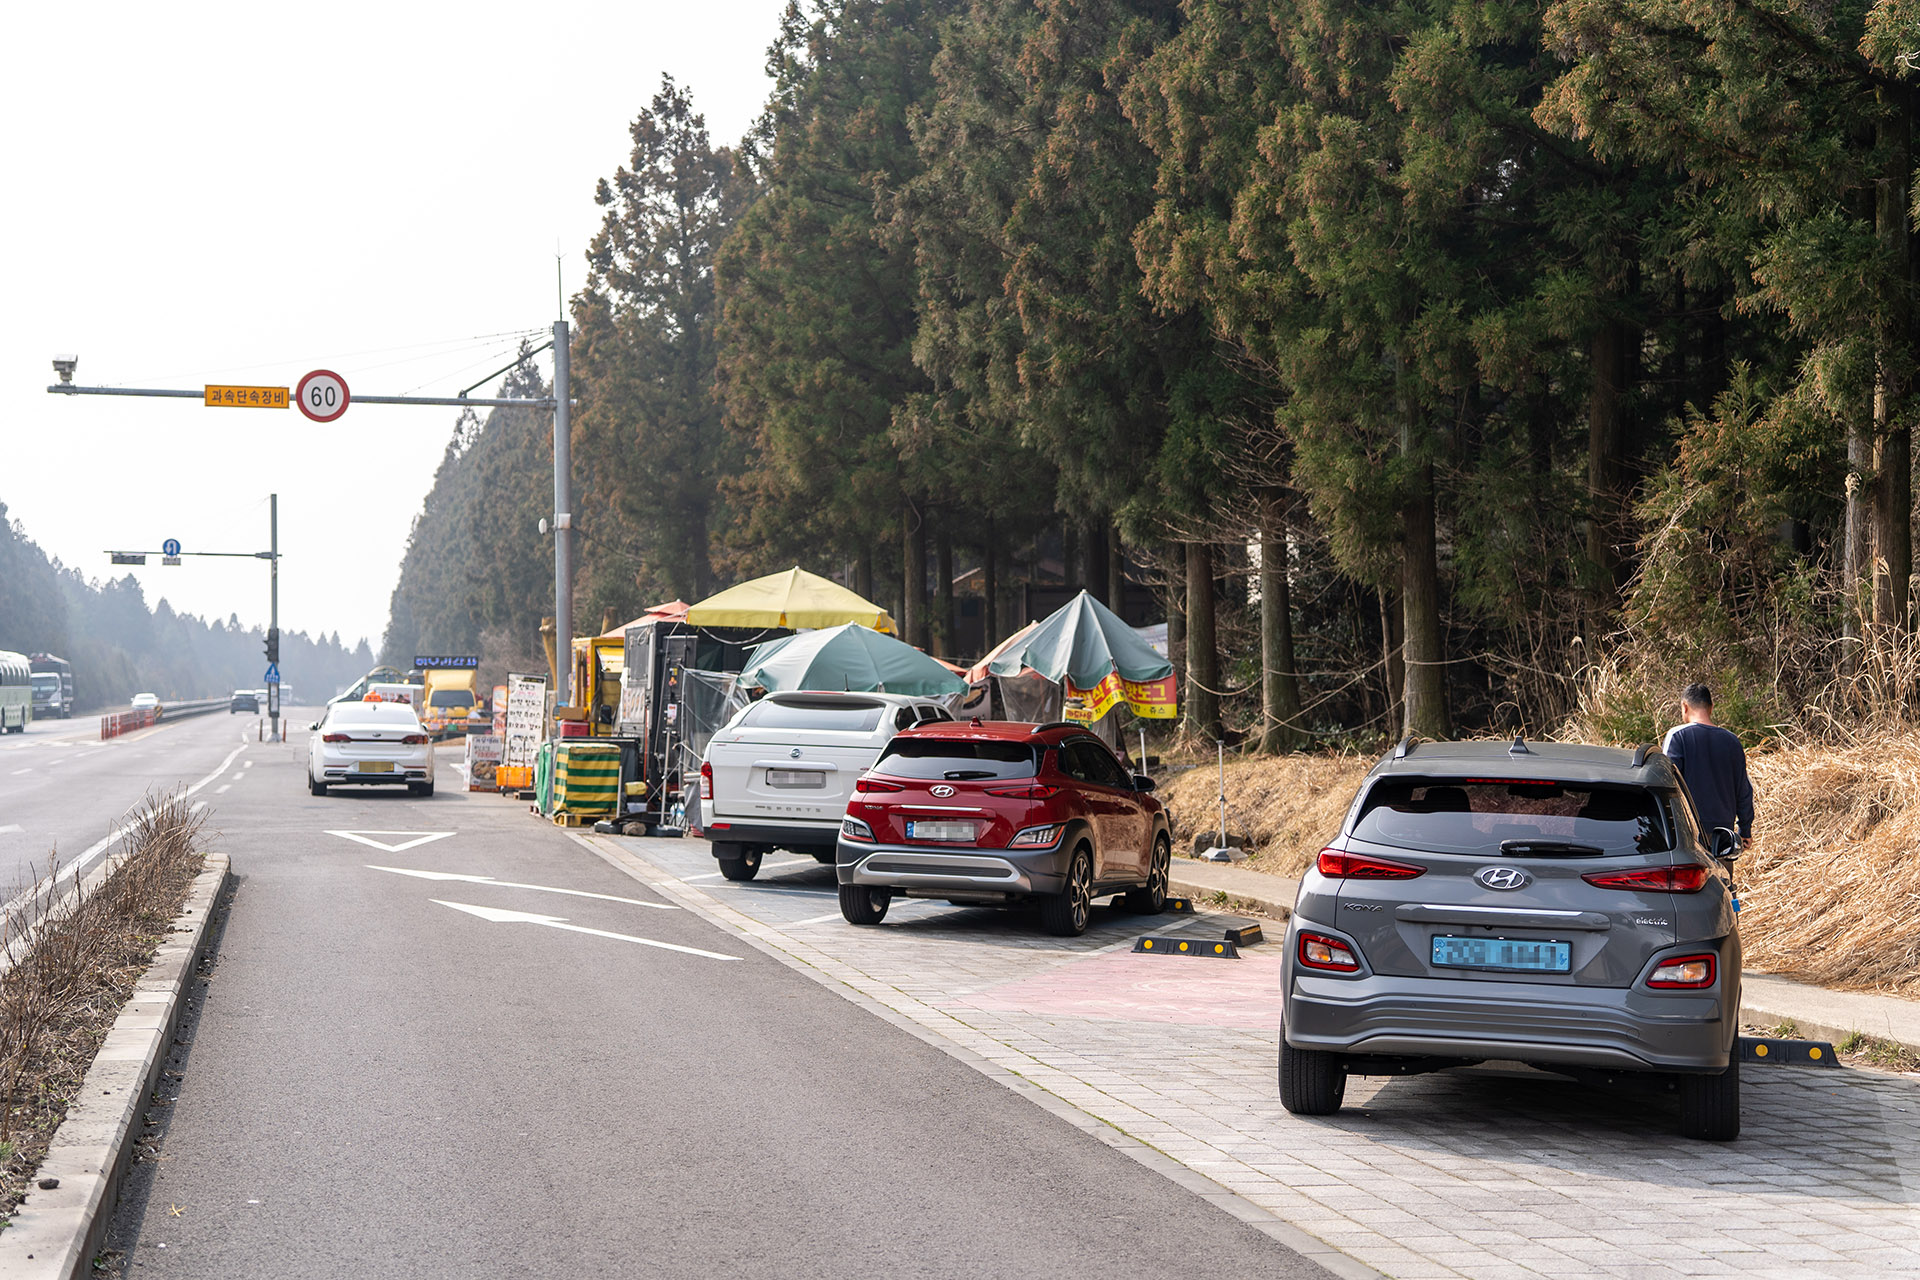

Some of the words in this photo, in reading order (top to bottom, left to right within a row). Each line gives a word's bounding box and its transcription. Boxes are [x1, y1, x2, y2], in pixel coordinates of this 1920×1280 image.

[211, 388, 285, 405] 과속단속장비
[311, 386, 336, 407] 60
[1125, 682, 1167, 701] 핫도그
[766, 805, 821, 813] SPORTS
[1343, 902, 1384, 912] KONA
[1635, 916, 1668, 926] electric
